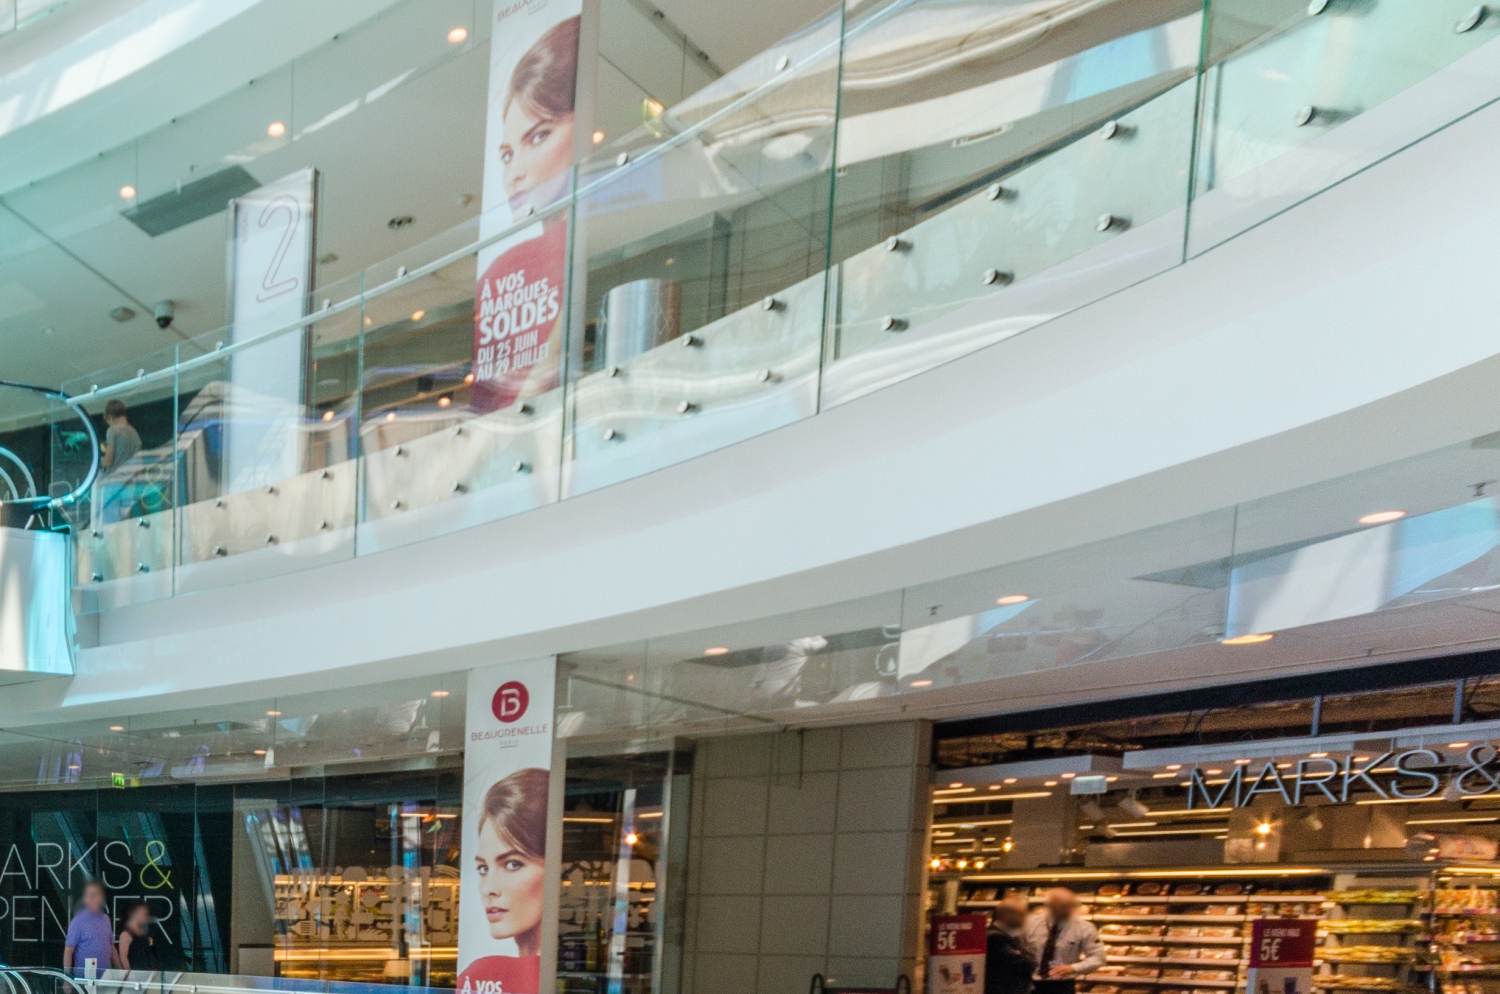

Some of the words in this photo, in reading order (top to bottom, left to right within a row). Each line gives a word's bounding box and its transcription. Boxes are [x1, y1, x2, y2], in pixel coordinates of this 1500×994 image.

[257, 194, 300, 303] 2
[495, 269, 525, 295] VOS
[480, 289, 560, 345] SOLDES
[476, 362, 494, 382] AU
[511, 341, 550, 372] JUILLET
[478, 345, 495, 365] DU
[496, 339, 512, 360] 25
[513, 329, 539, 354] JUIN
[471, 724, 548, 741] BEAUGRENELLE
[1187, 749, 1440, 811] MARKS
[1456, 744, 1500, 795] &
[139, 840, 175, 890] &
[937, 931, 957, 950] 5€
[1260, 938, 1282, 961] 5€
[461, 975, 471, 994] À
